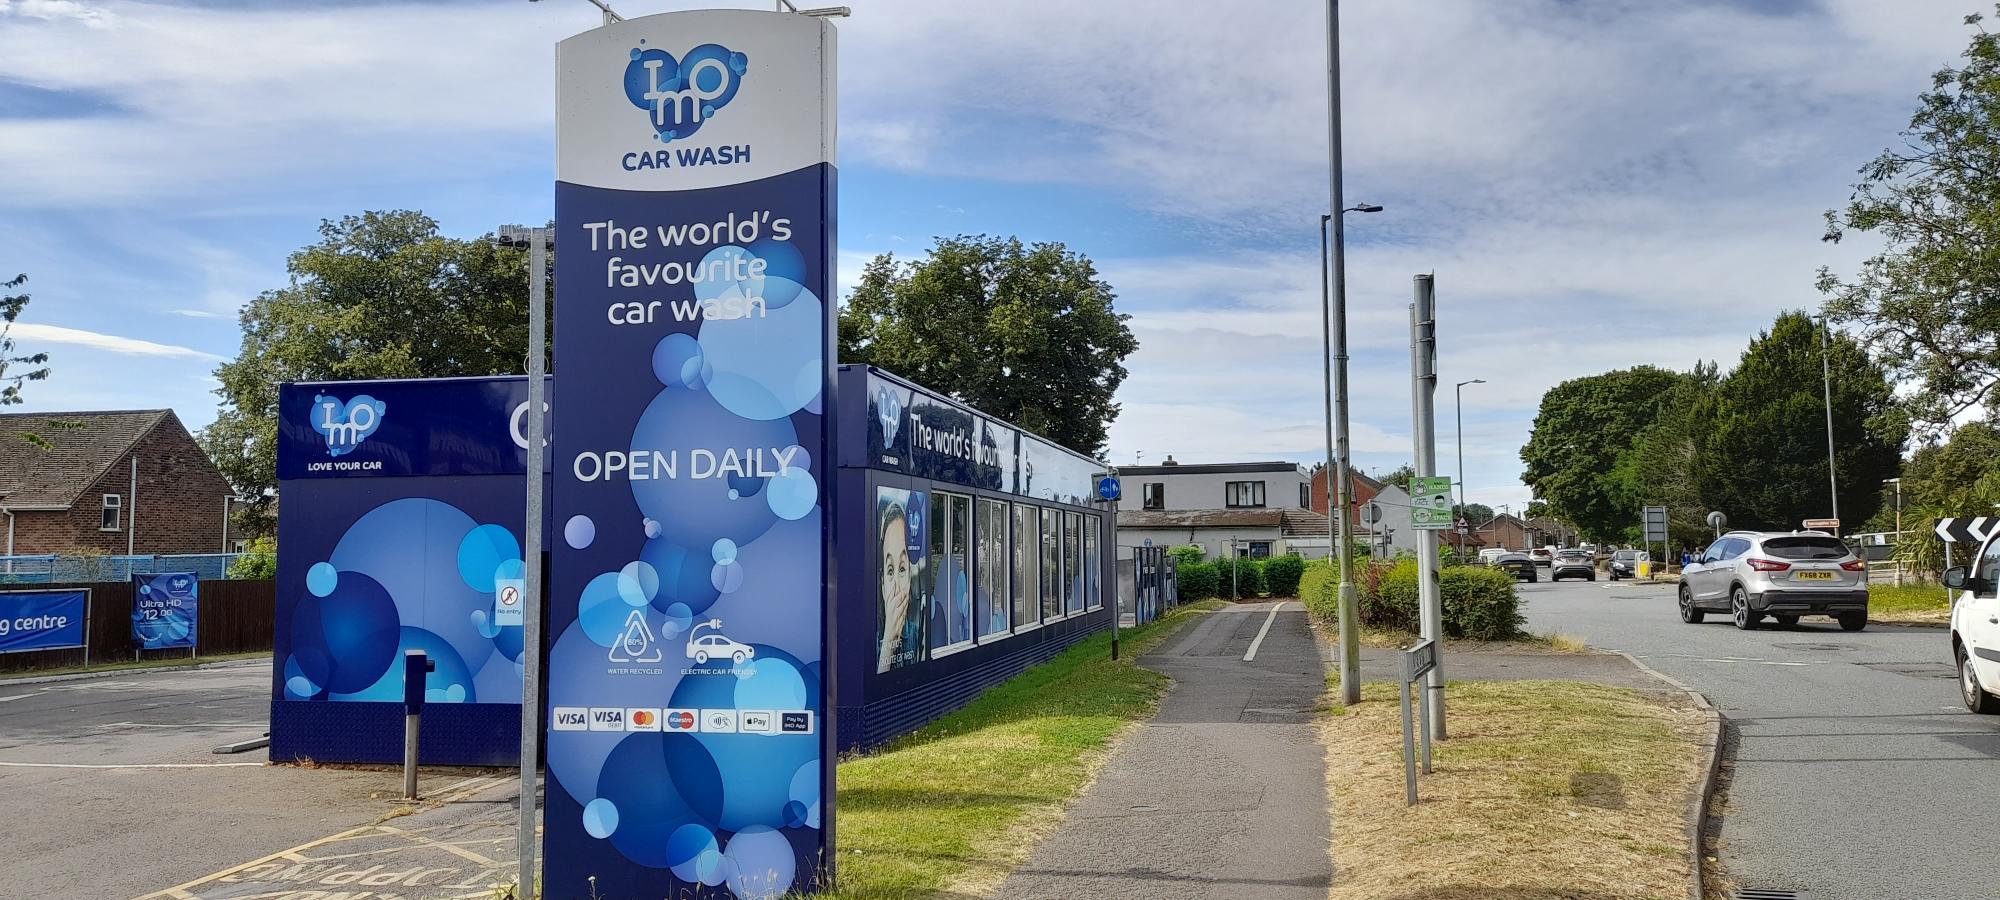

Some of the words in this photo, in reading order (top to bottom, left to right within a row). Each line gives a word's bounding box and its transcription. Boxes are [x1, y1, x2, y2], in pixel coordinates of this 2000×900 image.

[622, 150, 670, 171] CAR
[676, 145, 751, 168] WASH
[583, 220, 648, 251] The
[657, 210, 792, 247] world's
[607, 252, 767, 288] favourite
[607, 300, 661, 325] car
[671, 288, 766, 322] wash
[911, 413, 932, 451] The
[934, 425, 970, 461] world's
[308, 463, 332, 471] LOVE
[334, 462, 360, 470] YOUR
[362, 461, 382, 470] CAR
[573, 450, 677, 482] OPEN
[690, 447, 797, 479] DAILY
[140, 600, 164, 608] Ultra
[166, 599, 182, 607] HD
[14, 615, 67, 631] centre
[557, 713, 586, 725] VISA
[594, 711, 622, 722] VISA
[753, 718, 766, 726] Pay
